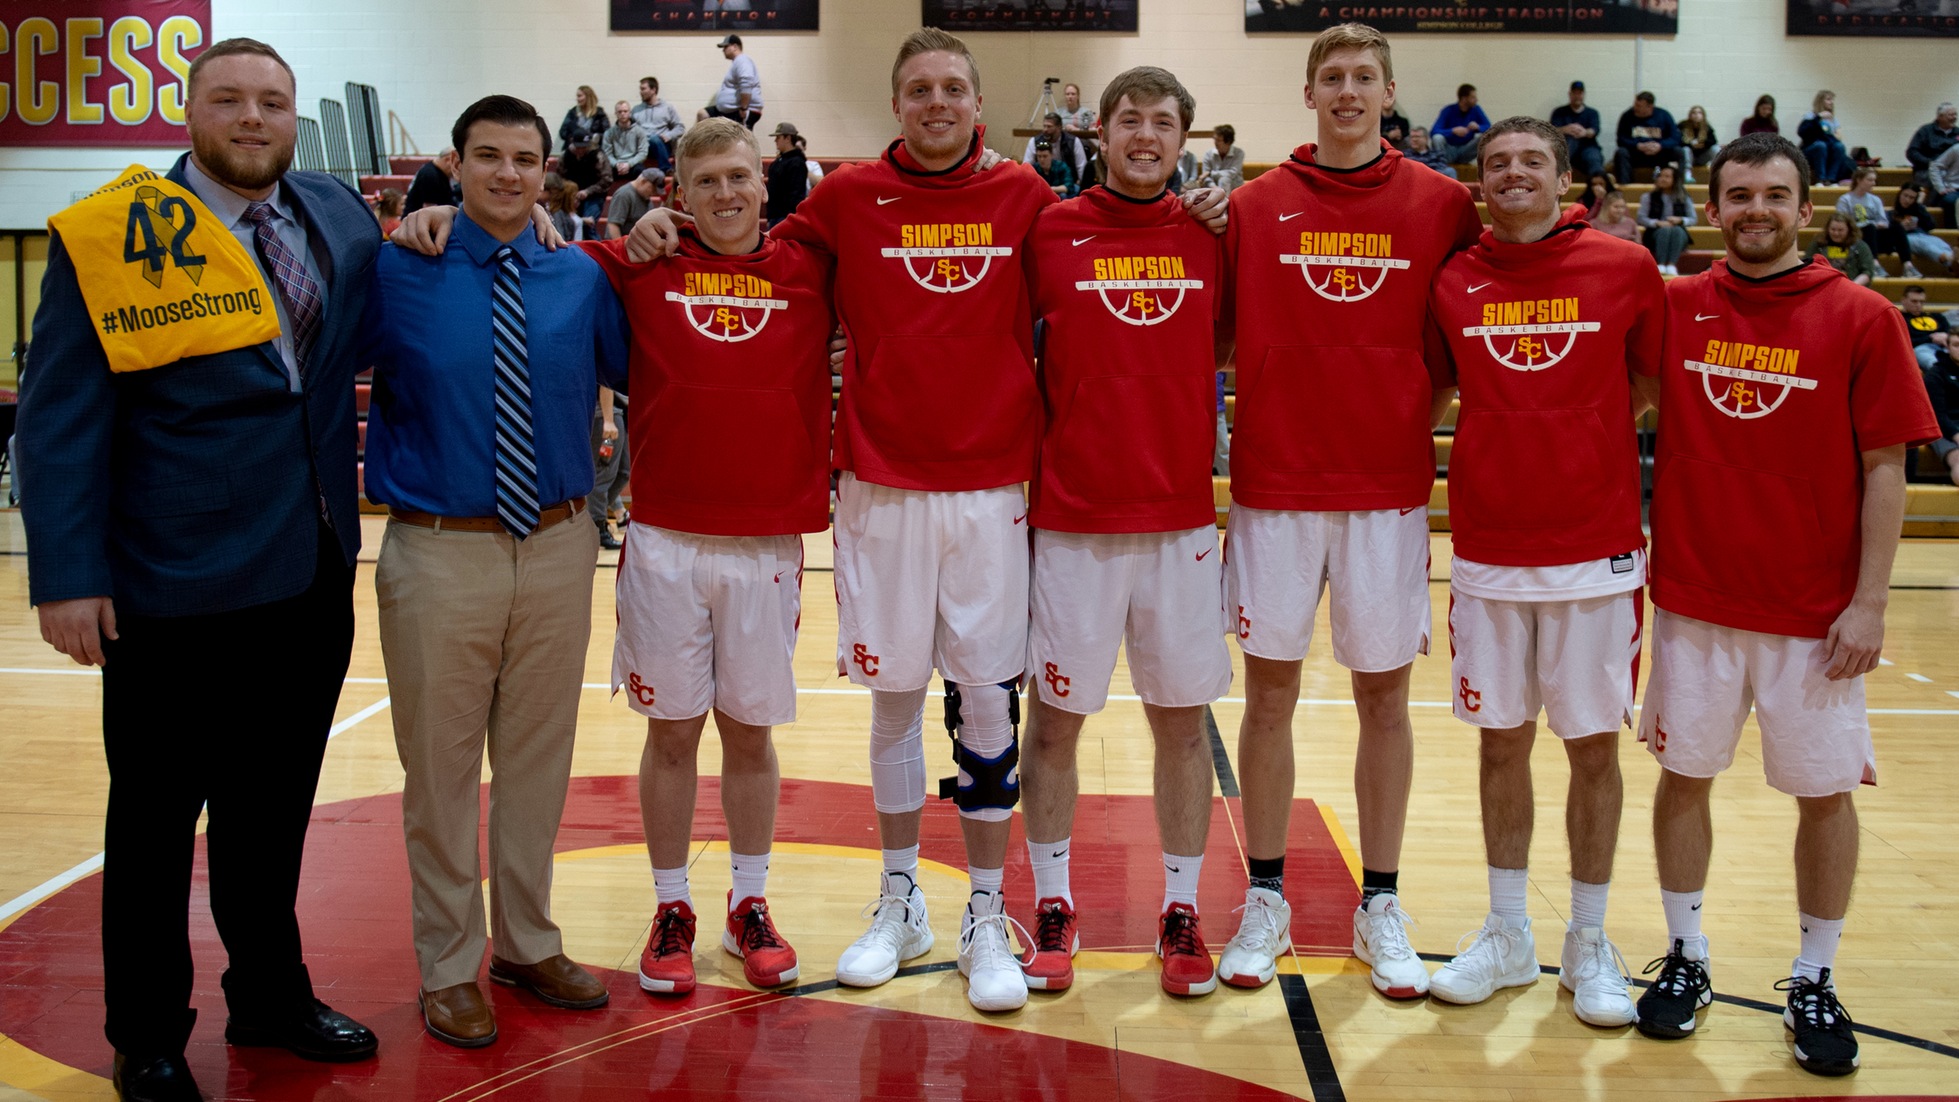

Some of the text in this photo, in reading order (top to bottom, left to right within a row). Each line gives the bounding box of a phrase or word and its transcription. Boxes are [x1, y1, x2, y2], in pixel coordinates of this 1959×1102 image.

[652, 11, 777, 20] CHAMPION
[949, 10, 1111, 20] COMMITMENT
[1319, 6, 1604, 20] A CHAMPIONSHIP TRADITION
[0, 15, 203, 126] CESS
[123, 196, 208, 273] 42
[901, 222, 993, 248] SIMPSON
[1300, 231, 1392, 258] SIMPSON
[893, 248, 1001, 256] BASKETBALL
[1291, 255, 1399, 267] BASKETBALL
[937, 258, 960, 281] SC
[1093, 256, 1186, 281] SIMPSON
[1333, 268, 1356, 290] SC
[684, 272, 773, 298] SIMPSON
[1088, 281, 1194, 289] BASKETBALL
[101, 287, 263, 335] #MooseStrong
[676, 294, 778, 308] BASKETBALL
[1132, 291, 1155, 314] SC
[1482, 297, 1579, 326] SIMPSON
[716, 307, 739, 330] SC
[1474, 324, 1587, 335] BASKETBALL
[1518, 336, 1542, 359] SC
[1703, 339, 1800, 375] SIMPSON
[1693, 363, 1803, 387] BASKETBALL
[1731, 381, 1755, 407] SC
[852, 642, 880, 678] SC
[628, 671, 655, 707] SC
[1044, 661, 1071, 699] SC
[1459, 675, 1481, 714] SC
